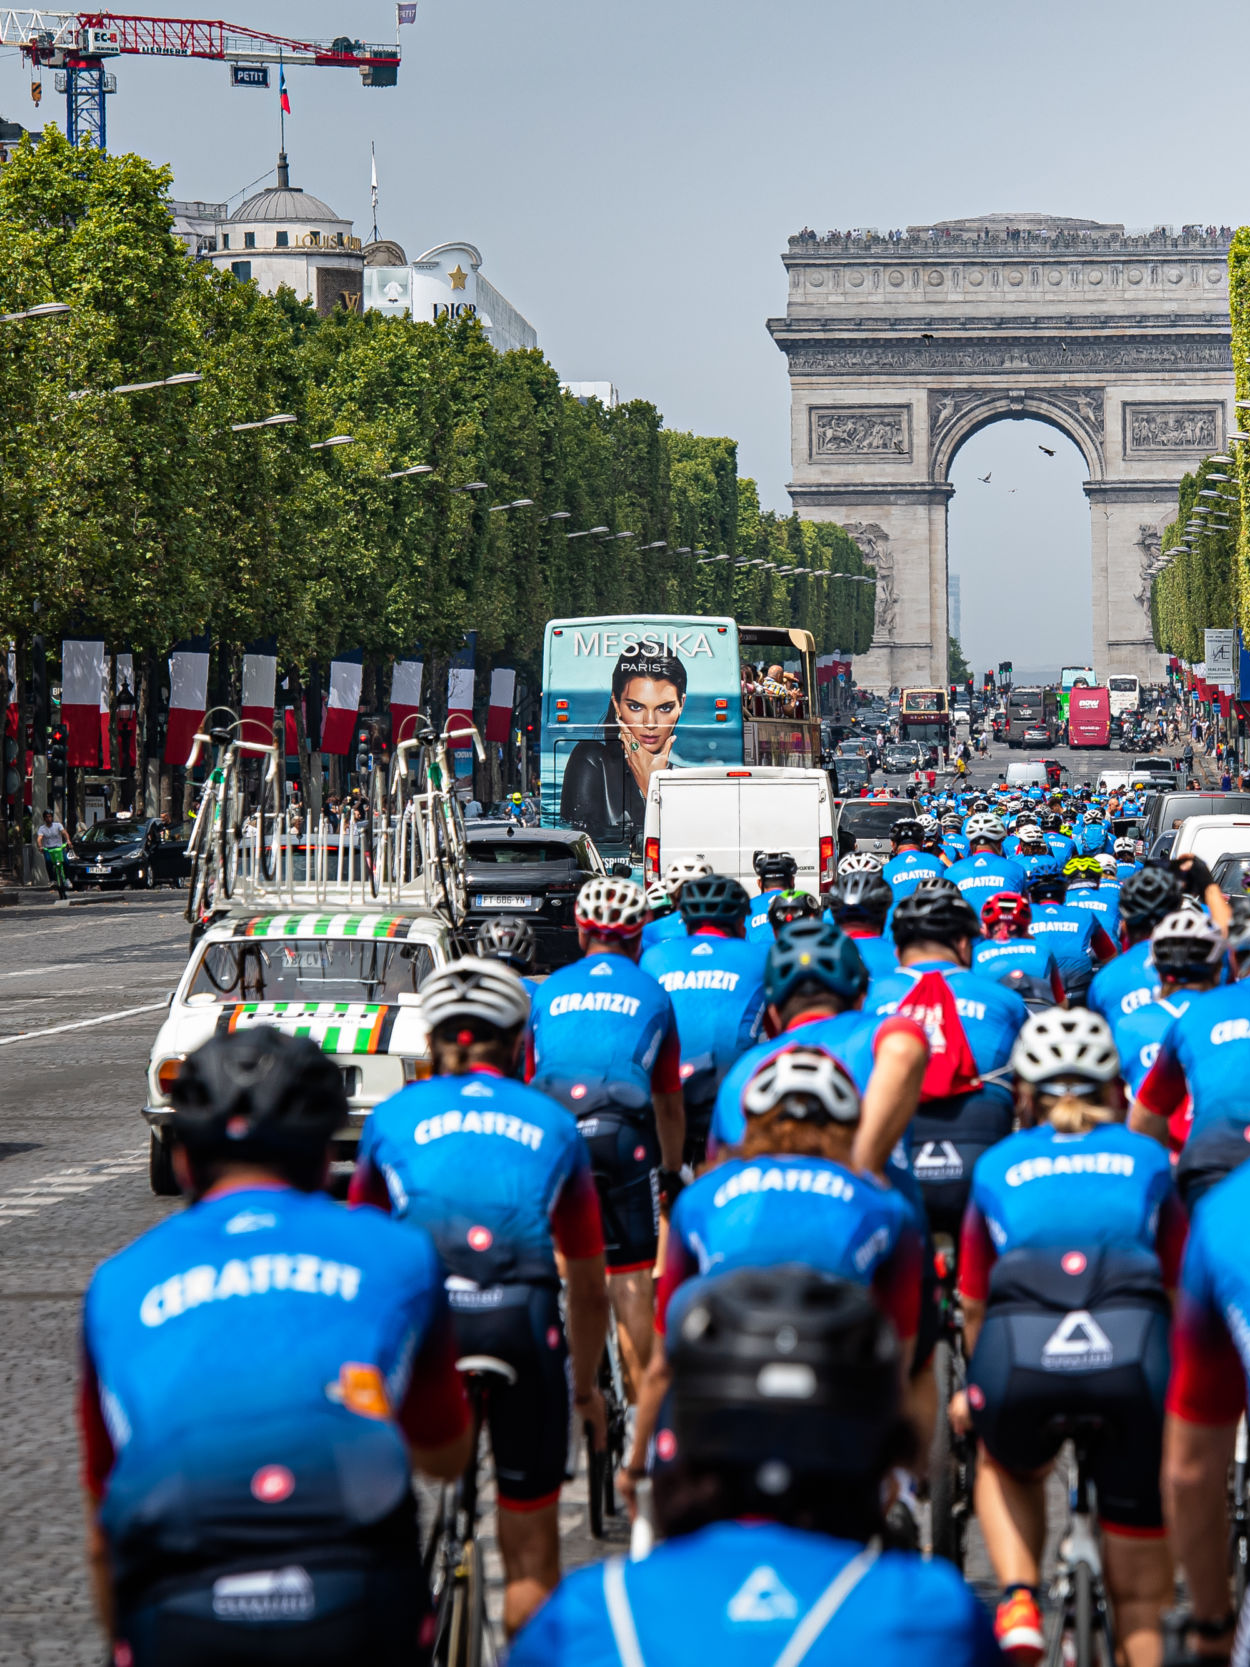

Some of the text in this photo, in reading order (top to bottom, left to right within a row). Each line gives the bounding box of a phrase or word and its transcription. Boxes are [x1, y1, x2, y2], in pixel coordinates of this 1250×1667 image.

[237, 70, 264, 83] PETIT
[295, 233, 338, 249] LOUIS
[573, 631, 714, 658] MESSIKA
[620, 662, 663, 673] PARIS
[892, 869, 937, 885] CERATIZIT
[957, 875, 1005, 891] CERATIZIT
[1028, 921, 1079, 935] CERATIZIT
[549, 991, 641, 1017] CERATIZIT
[413, 1110, 545, 1152] CERATIZIT
[1004, 1151, 1135, 1188] CERATIZIT
[139, 1253, 363, 1328] CERATIZIT
